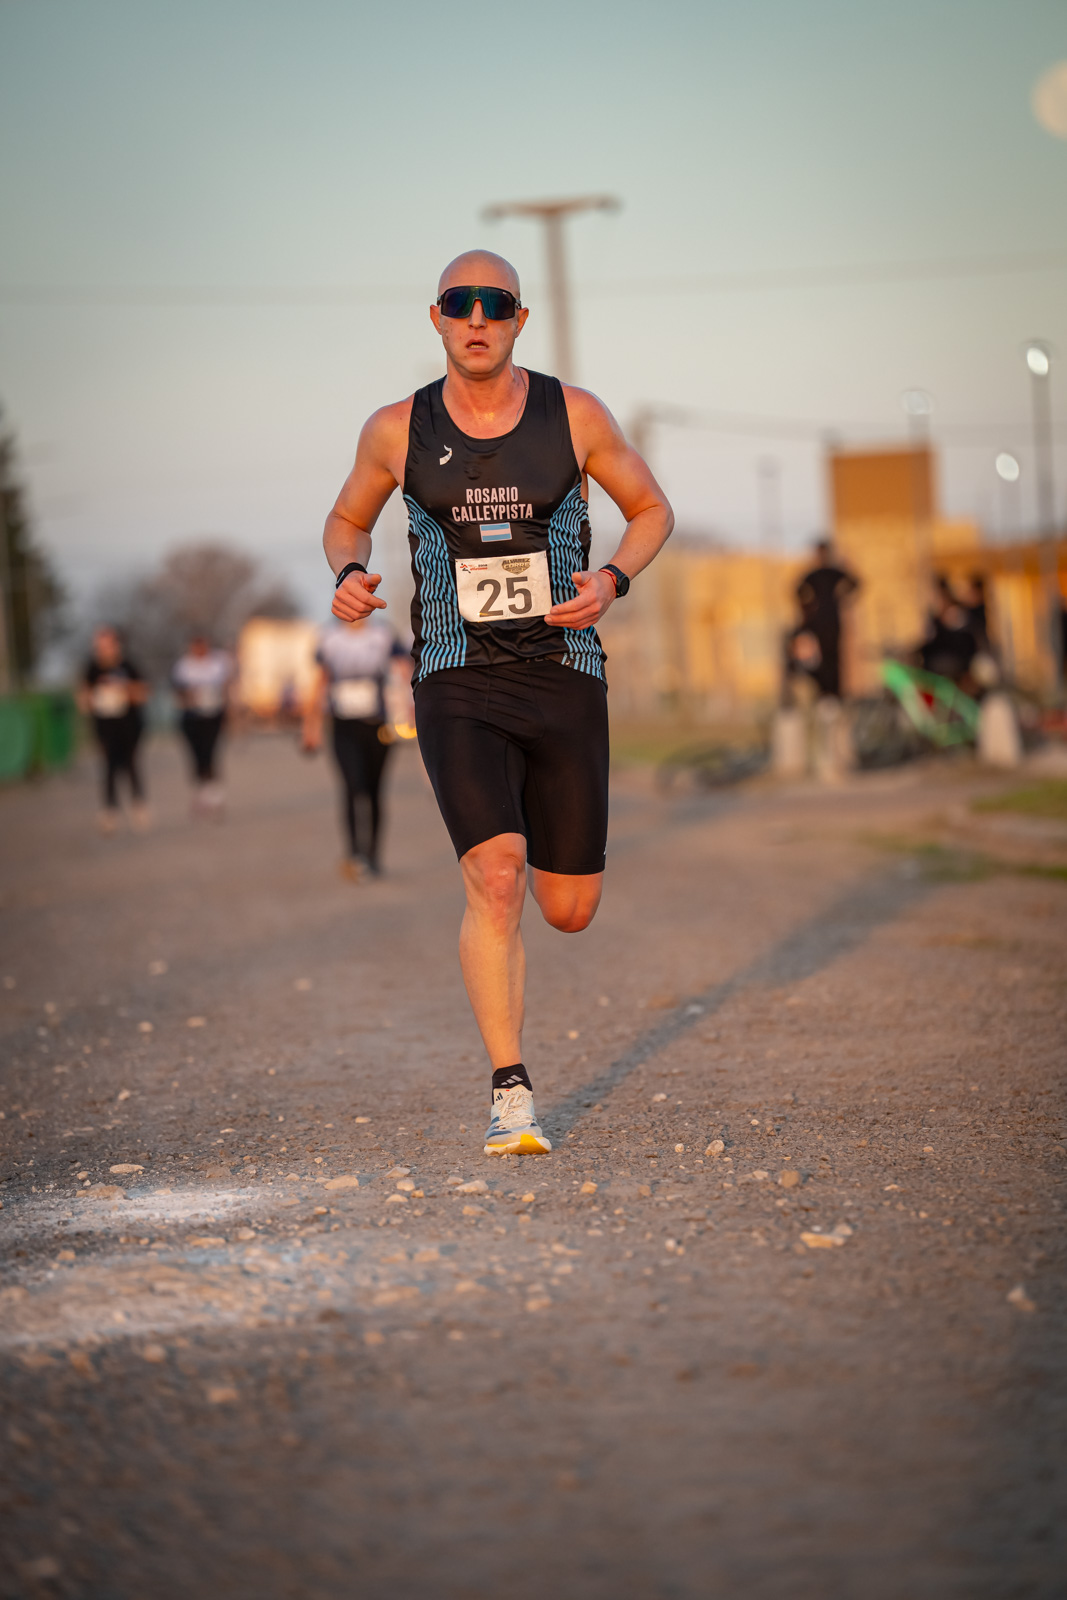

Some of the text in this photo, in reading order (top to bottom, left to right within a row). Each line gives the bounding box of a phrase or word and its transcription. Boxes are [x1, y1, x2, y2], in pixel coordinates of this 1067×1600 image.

[465, 486, 519, 504] ROSARIO
[451, 504, 533, 522] CALLEYPISTA
[476, 576, 533, 617] 25
